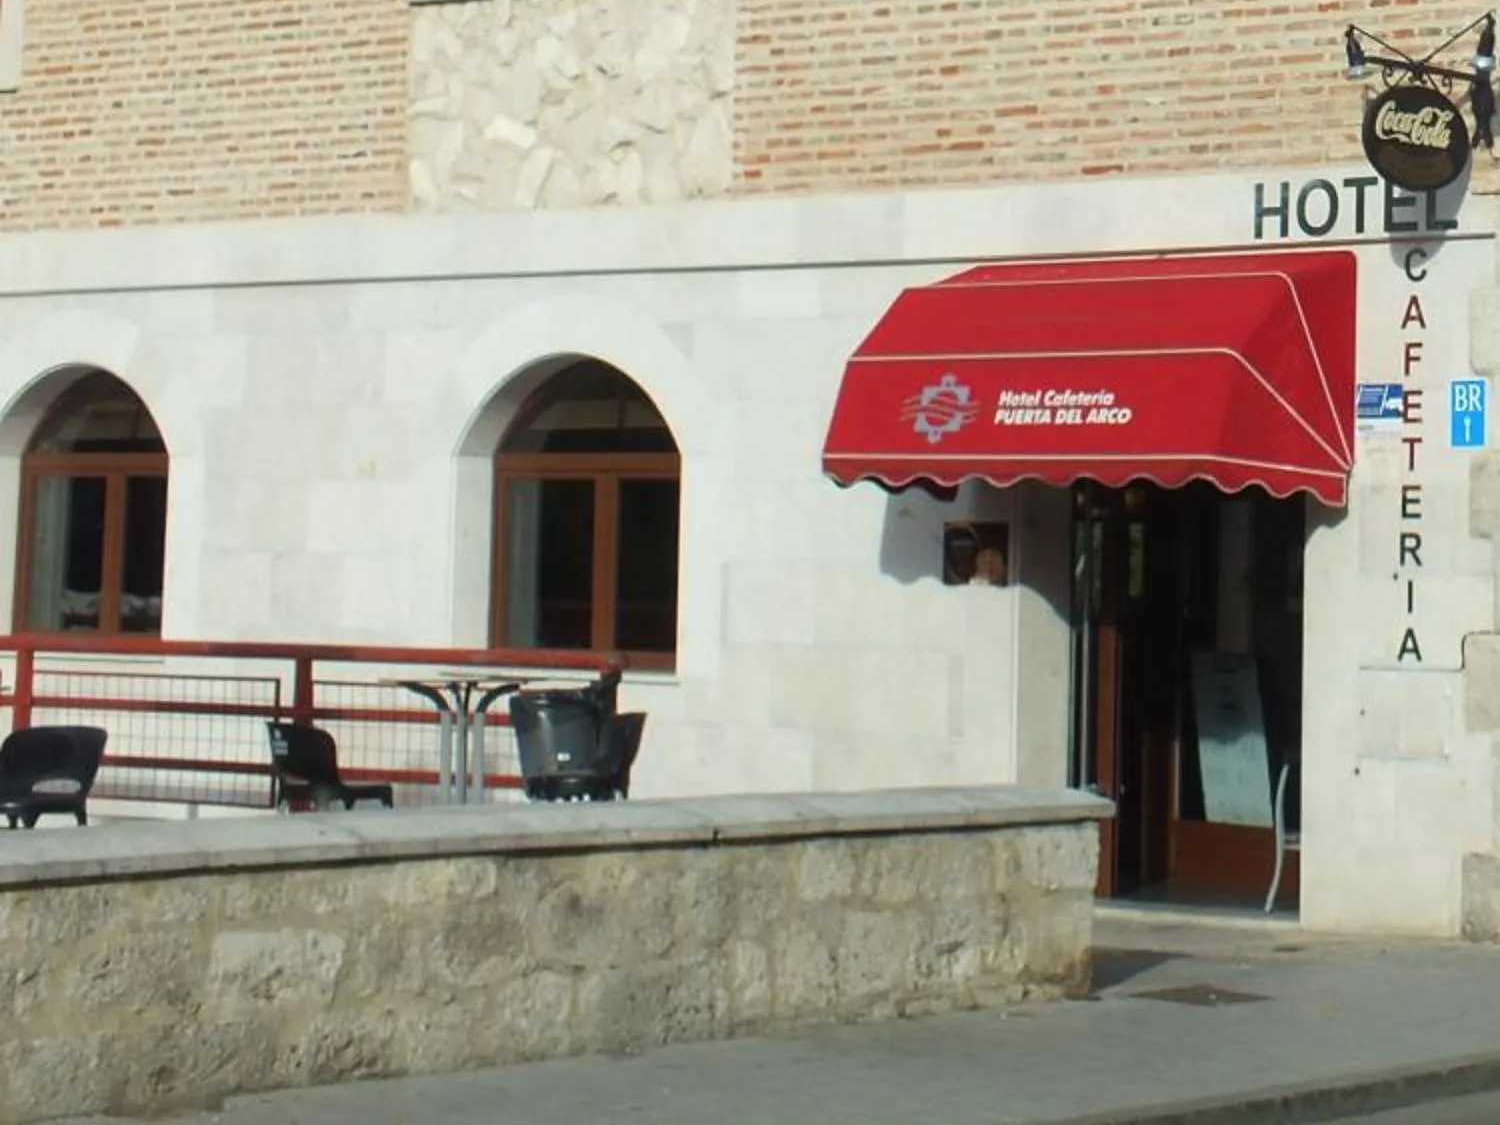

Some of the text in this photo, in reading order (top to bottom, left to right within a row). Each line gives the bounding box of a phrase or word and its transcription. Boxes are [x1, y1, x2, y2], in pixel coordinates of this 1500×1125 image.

[1254, 177, 1458, 239] HOTEL
[998, 389, 1041, 407] Hotel
[1454, 383, 1483, 412] BR
[994, 407, 1133, 425] PUERTA DEL ARCO
[1397, 247, 1427, 662] CAFETERIA
